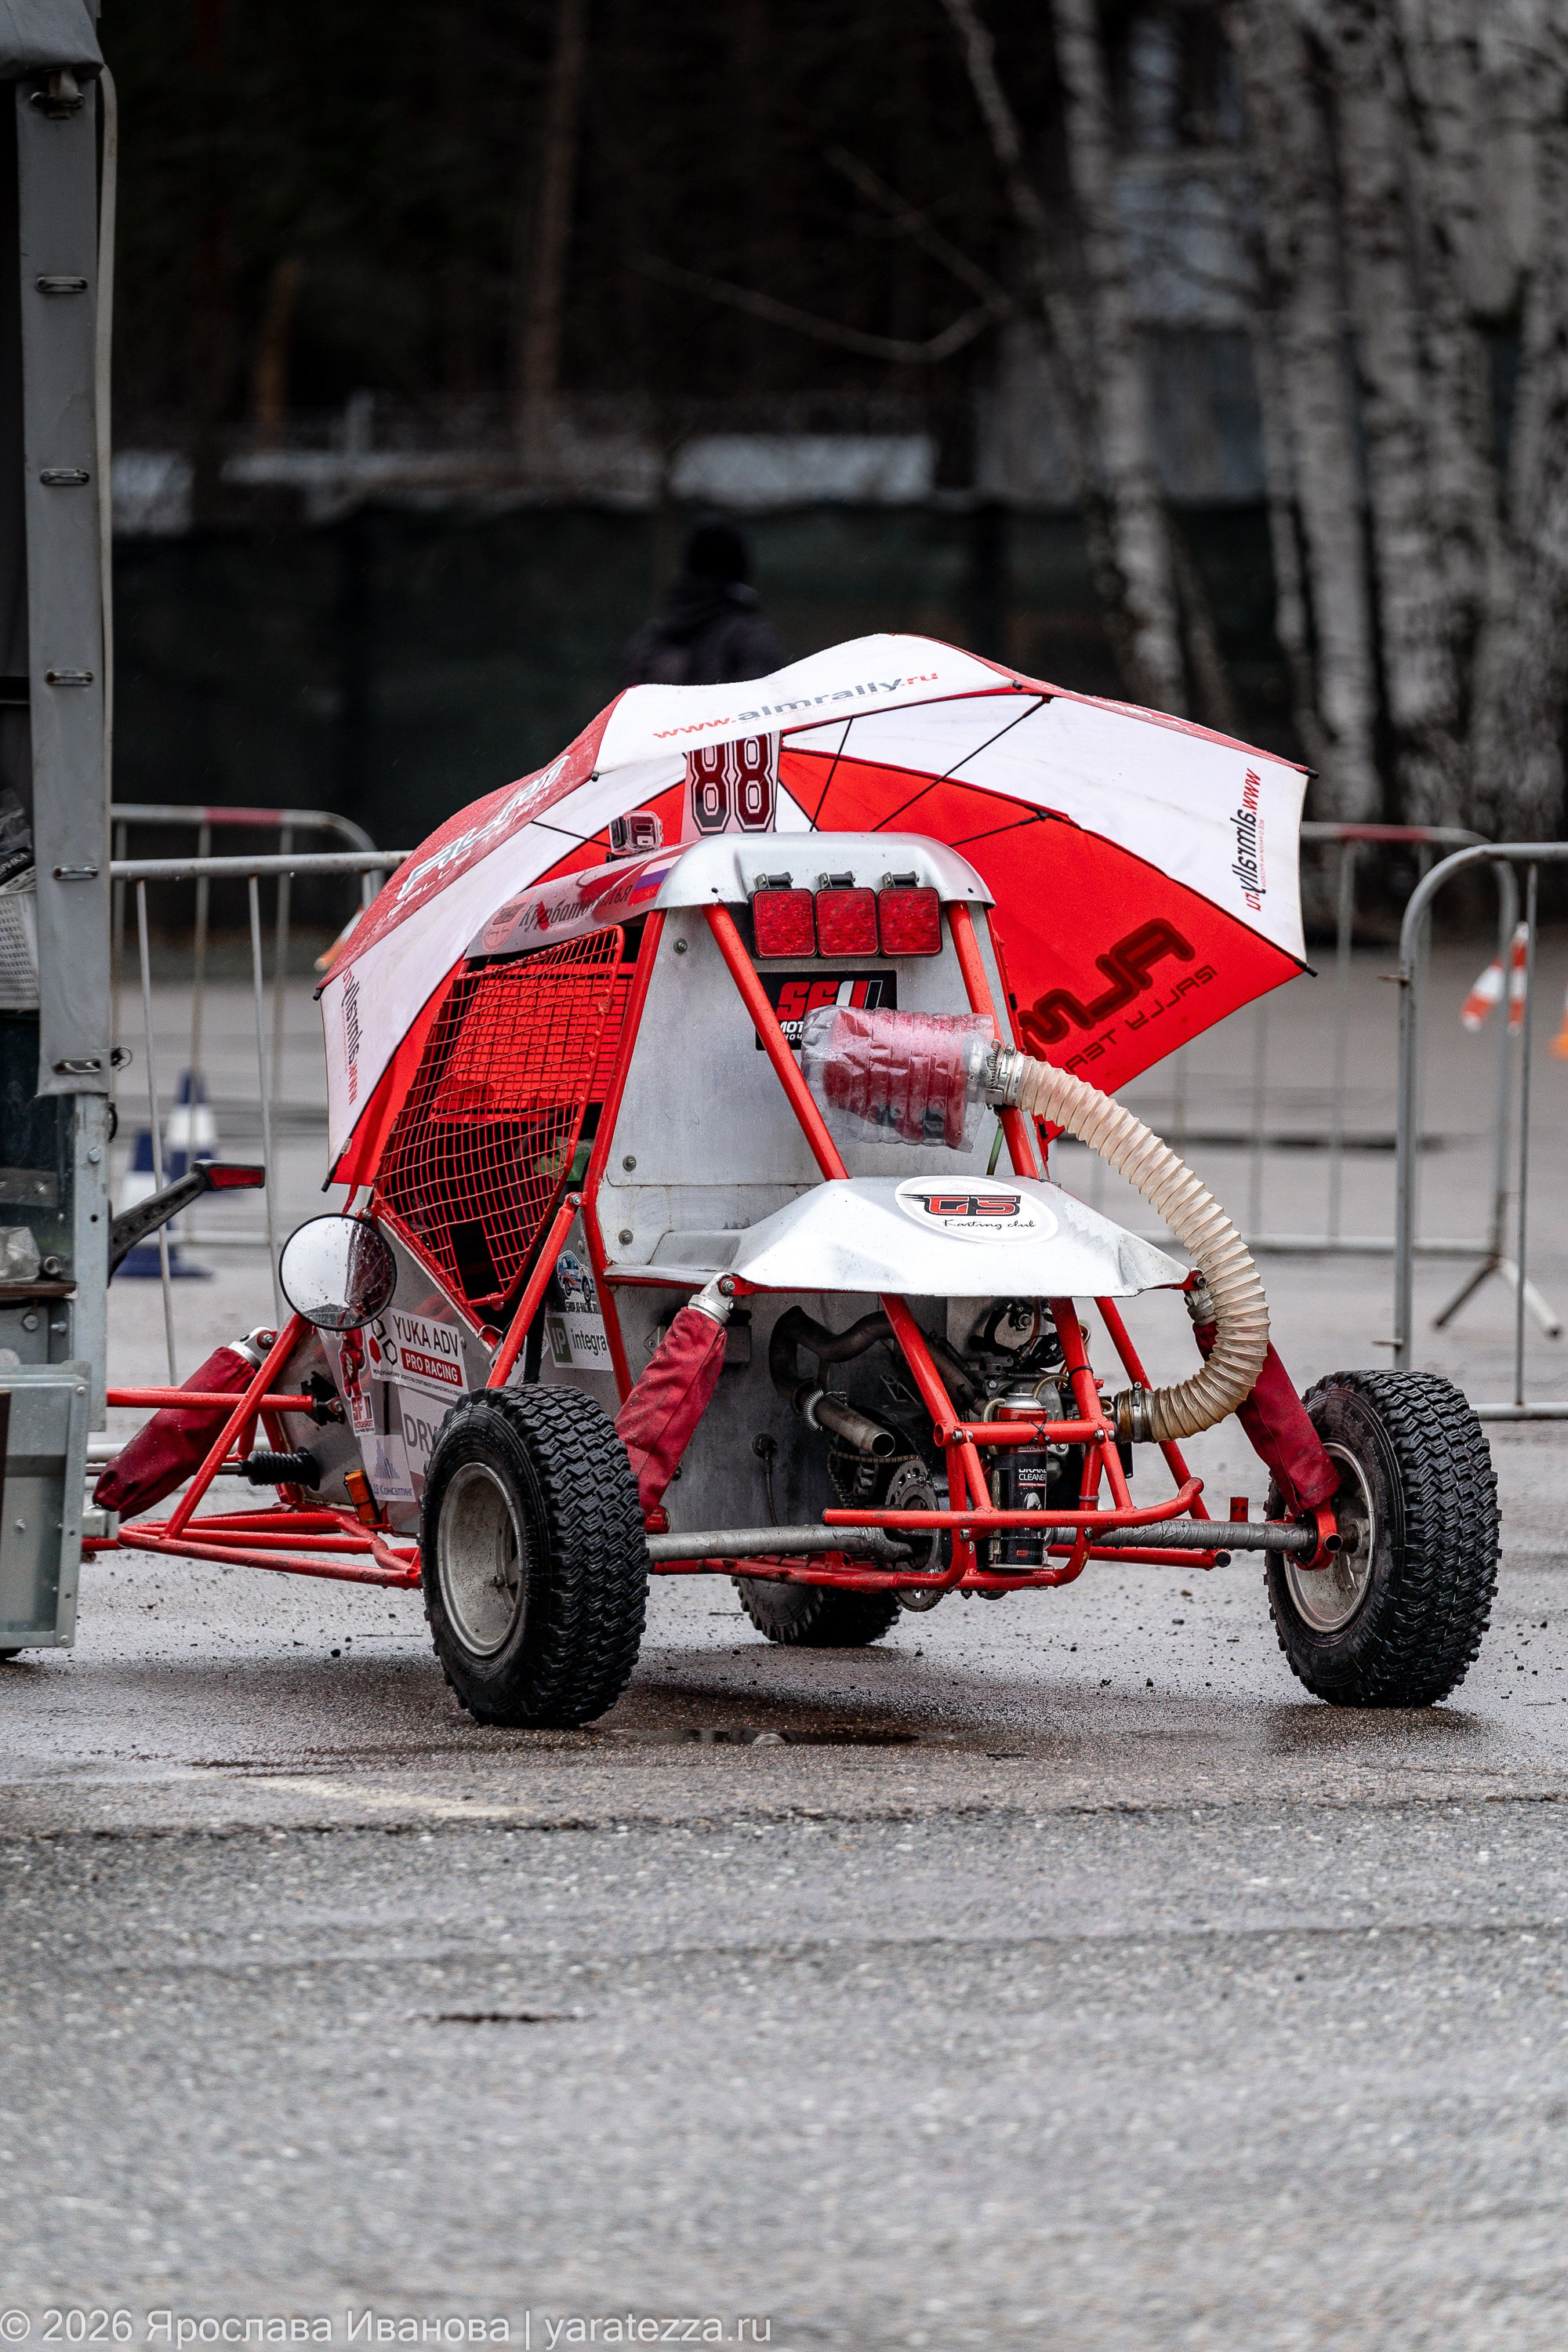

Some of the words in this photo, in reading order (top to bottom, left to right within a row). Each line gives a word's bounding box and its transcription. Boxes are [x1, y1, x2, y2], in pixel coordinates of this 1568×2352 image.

[653, 672, 939, 739] www.almrally.ru
[688, 733, 775, 836] 88
[943, 1219, 1003, 1229] Karting
[392, 1315, 431, 1348] YUKA
[434, 1327, 458, 1356] ADV
[571, 1329, 608, 1356] integra
[405, 1352, 423, 1371] PRO
[424, 1358, 458, 1382] RACING
[404, 1414, 439, 1455] DRY
